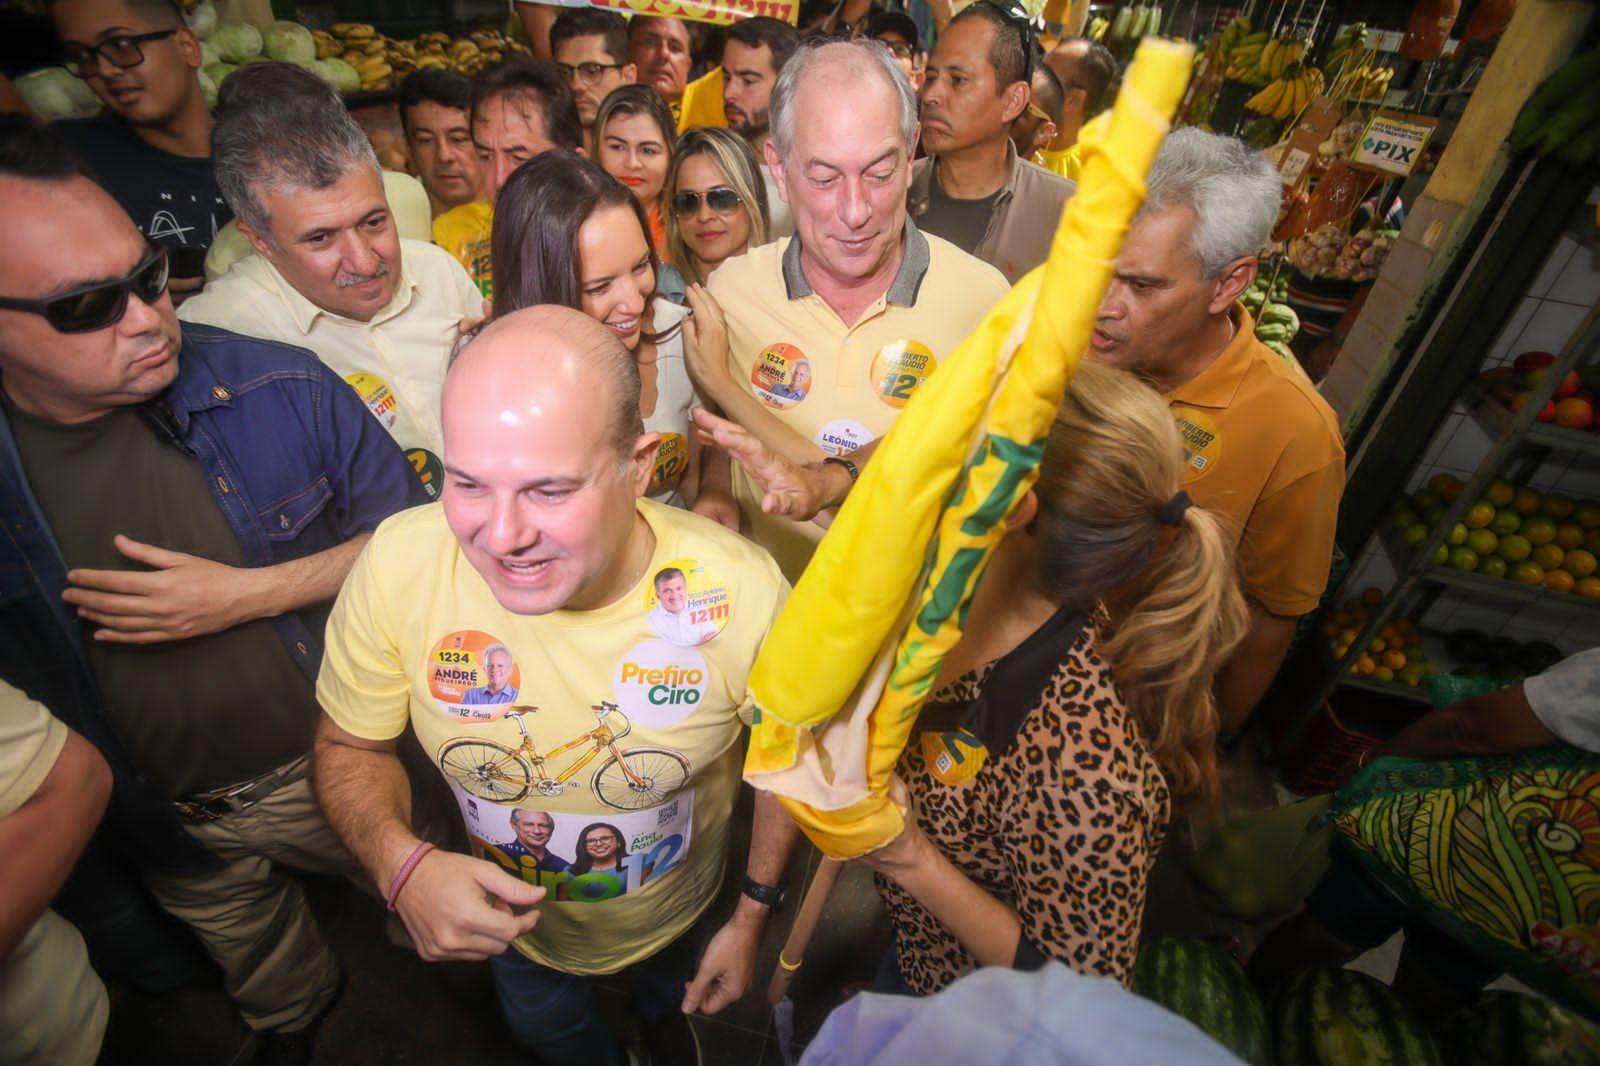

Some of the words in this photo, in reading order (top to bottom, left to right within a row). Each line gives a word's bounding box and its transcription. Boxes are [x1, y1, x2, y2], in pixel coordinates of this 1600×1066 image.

[1373, 139, 1417, 163] PIX
[767, 352, 786, 366] 1234
[884, 373, 917, 400] 12
[656, 456, 679, 482] 12
[689, 605, 729, 625] 12111
[439, 651, 470, 663] 1234
[435, 668, 478, 681] ANDRÉ
[621, 662, 703, 685] Prefiro
[648, 684, 700, 705] Ciro
[459, 708, 470, 717] 12
[631, 832, 656, 846] Ana
[621, 833, 683, 896] 12
